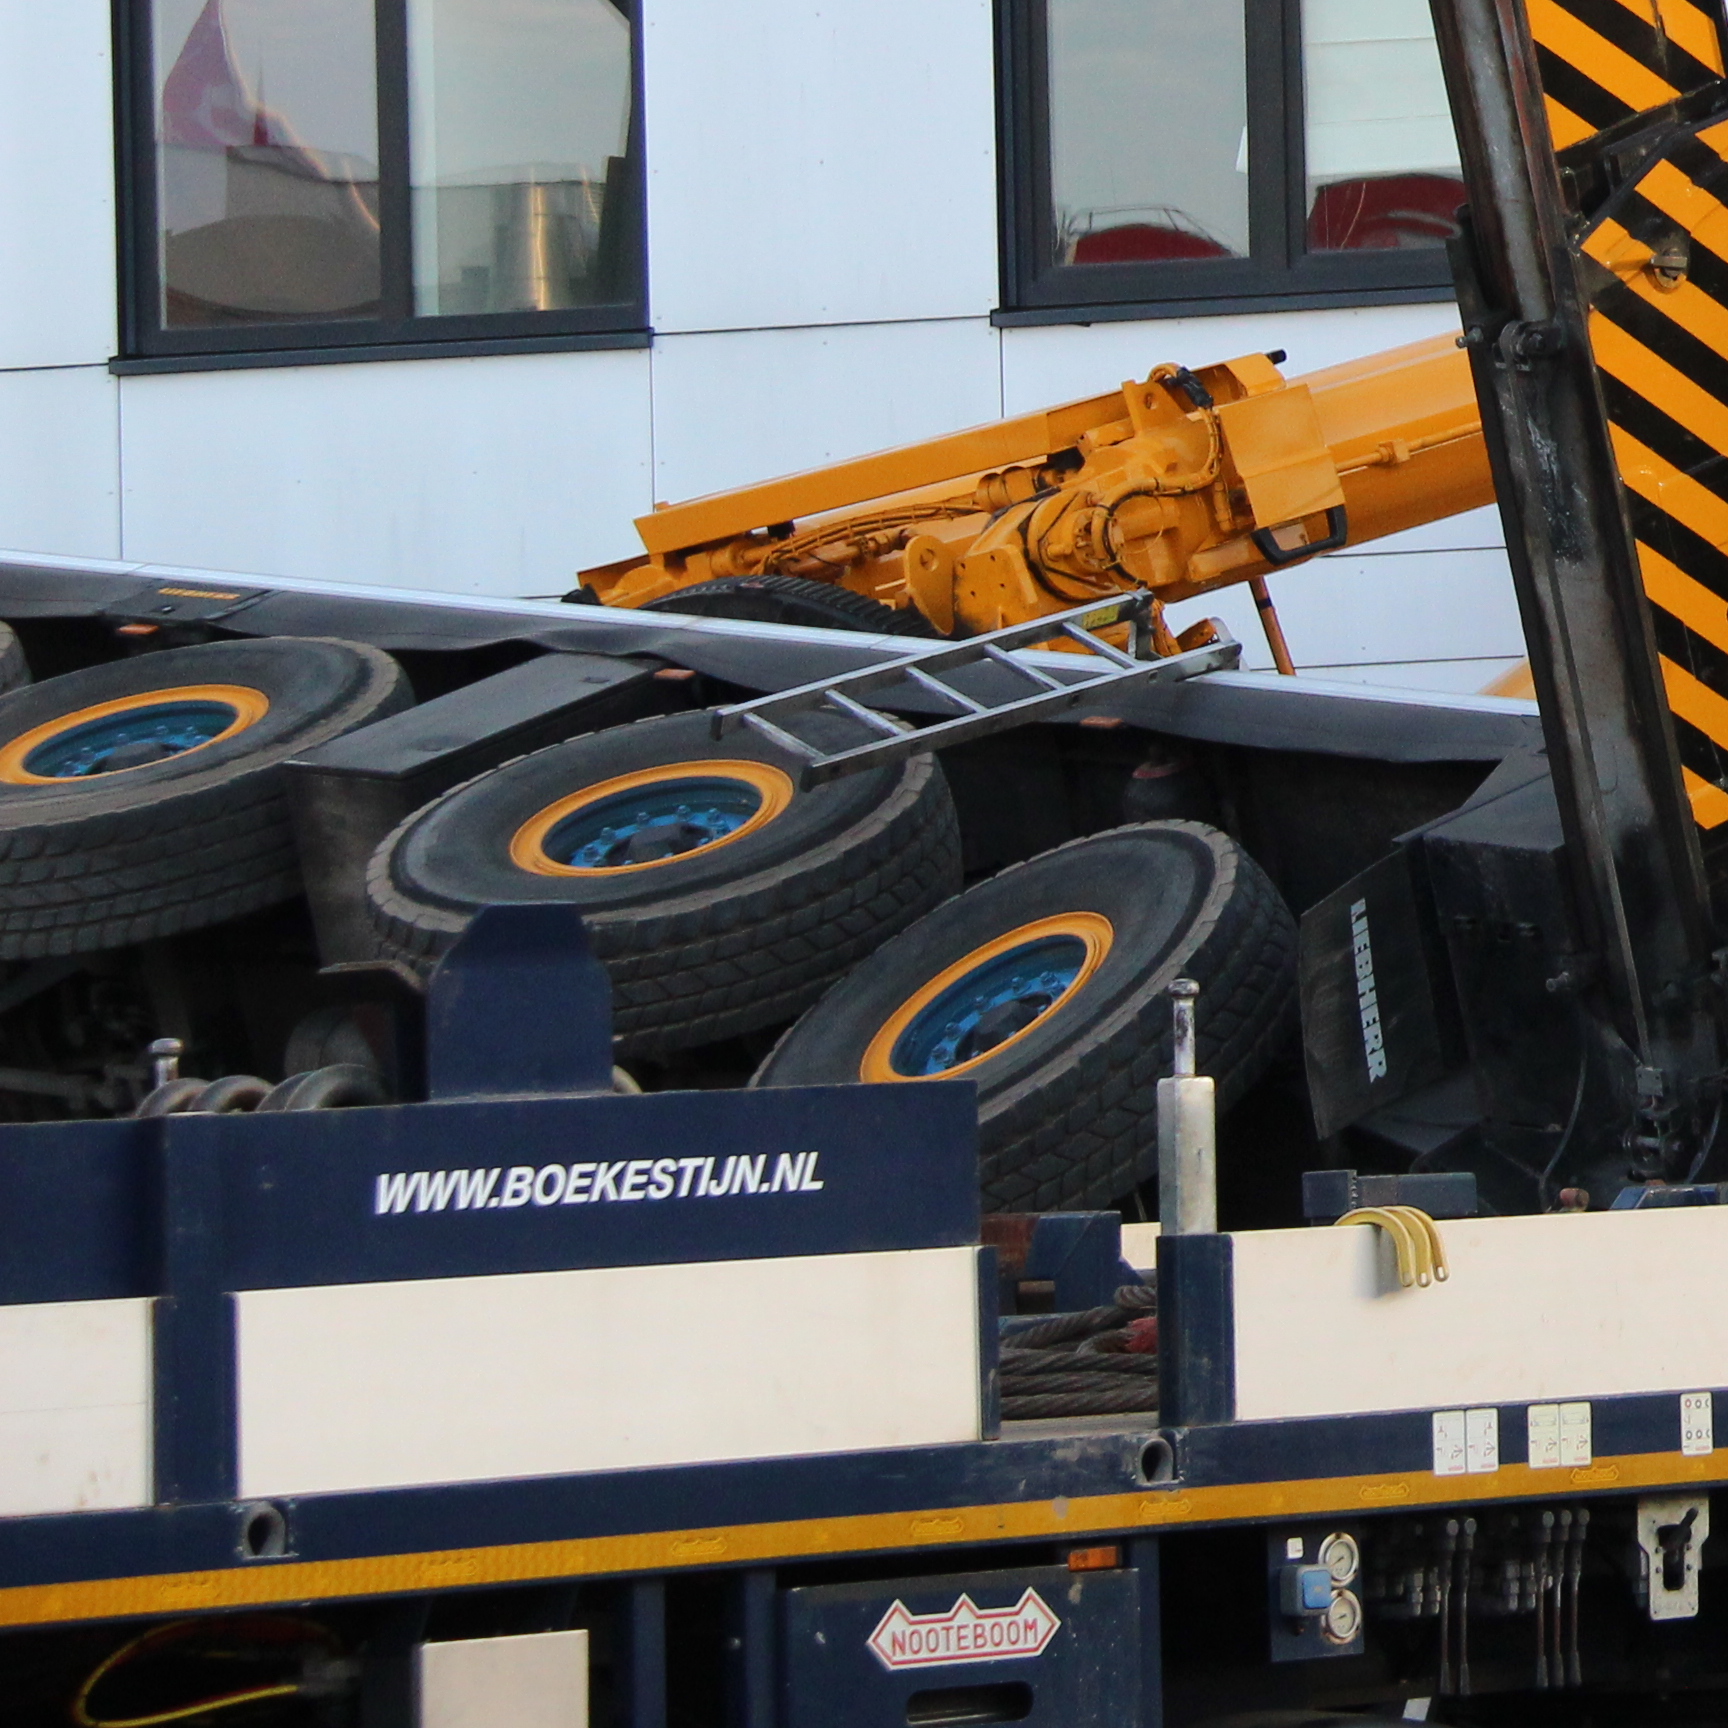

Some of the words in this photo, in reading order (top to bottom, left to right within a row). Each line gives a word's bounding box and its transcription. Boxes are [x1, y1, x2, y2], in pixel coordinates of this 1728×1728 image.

[1350, 897, 1388, 1084] LIEBHERR
[373, 1151, 825, 1215] WWW.BOEKESTIJN.NL
[891, 1617, 1040, 1657] NOOTEBOOM
